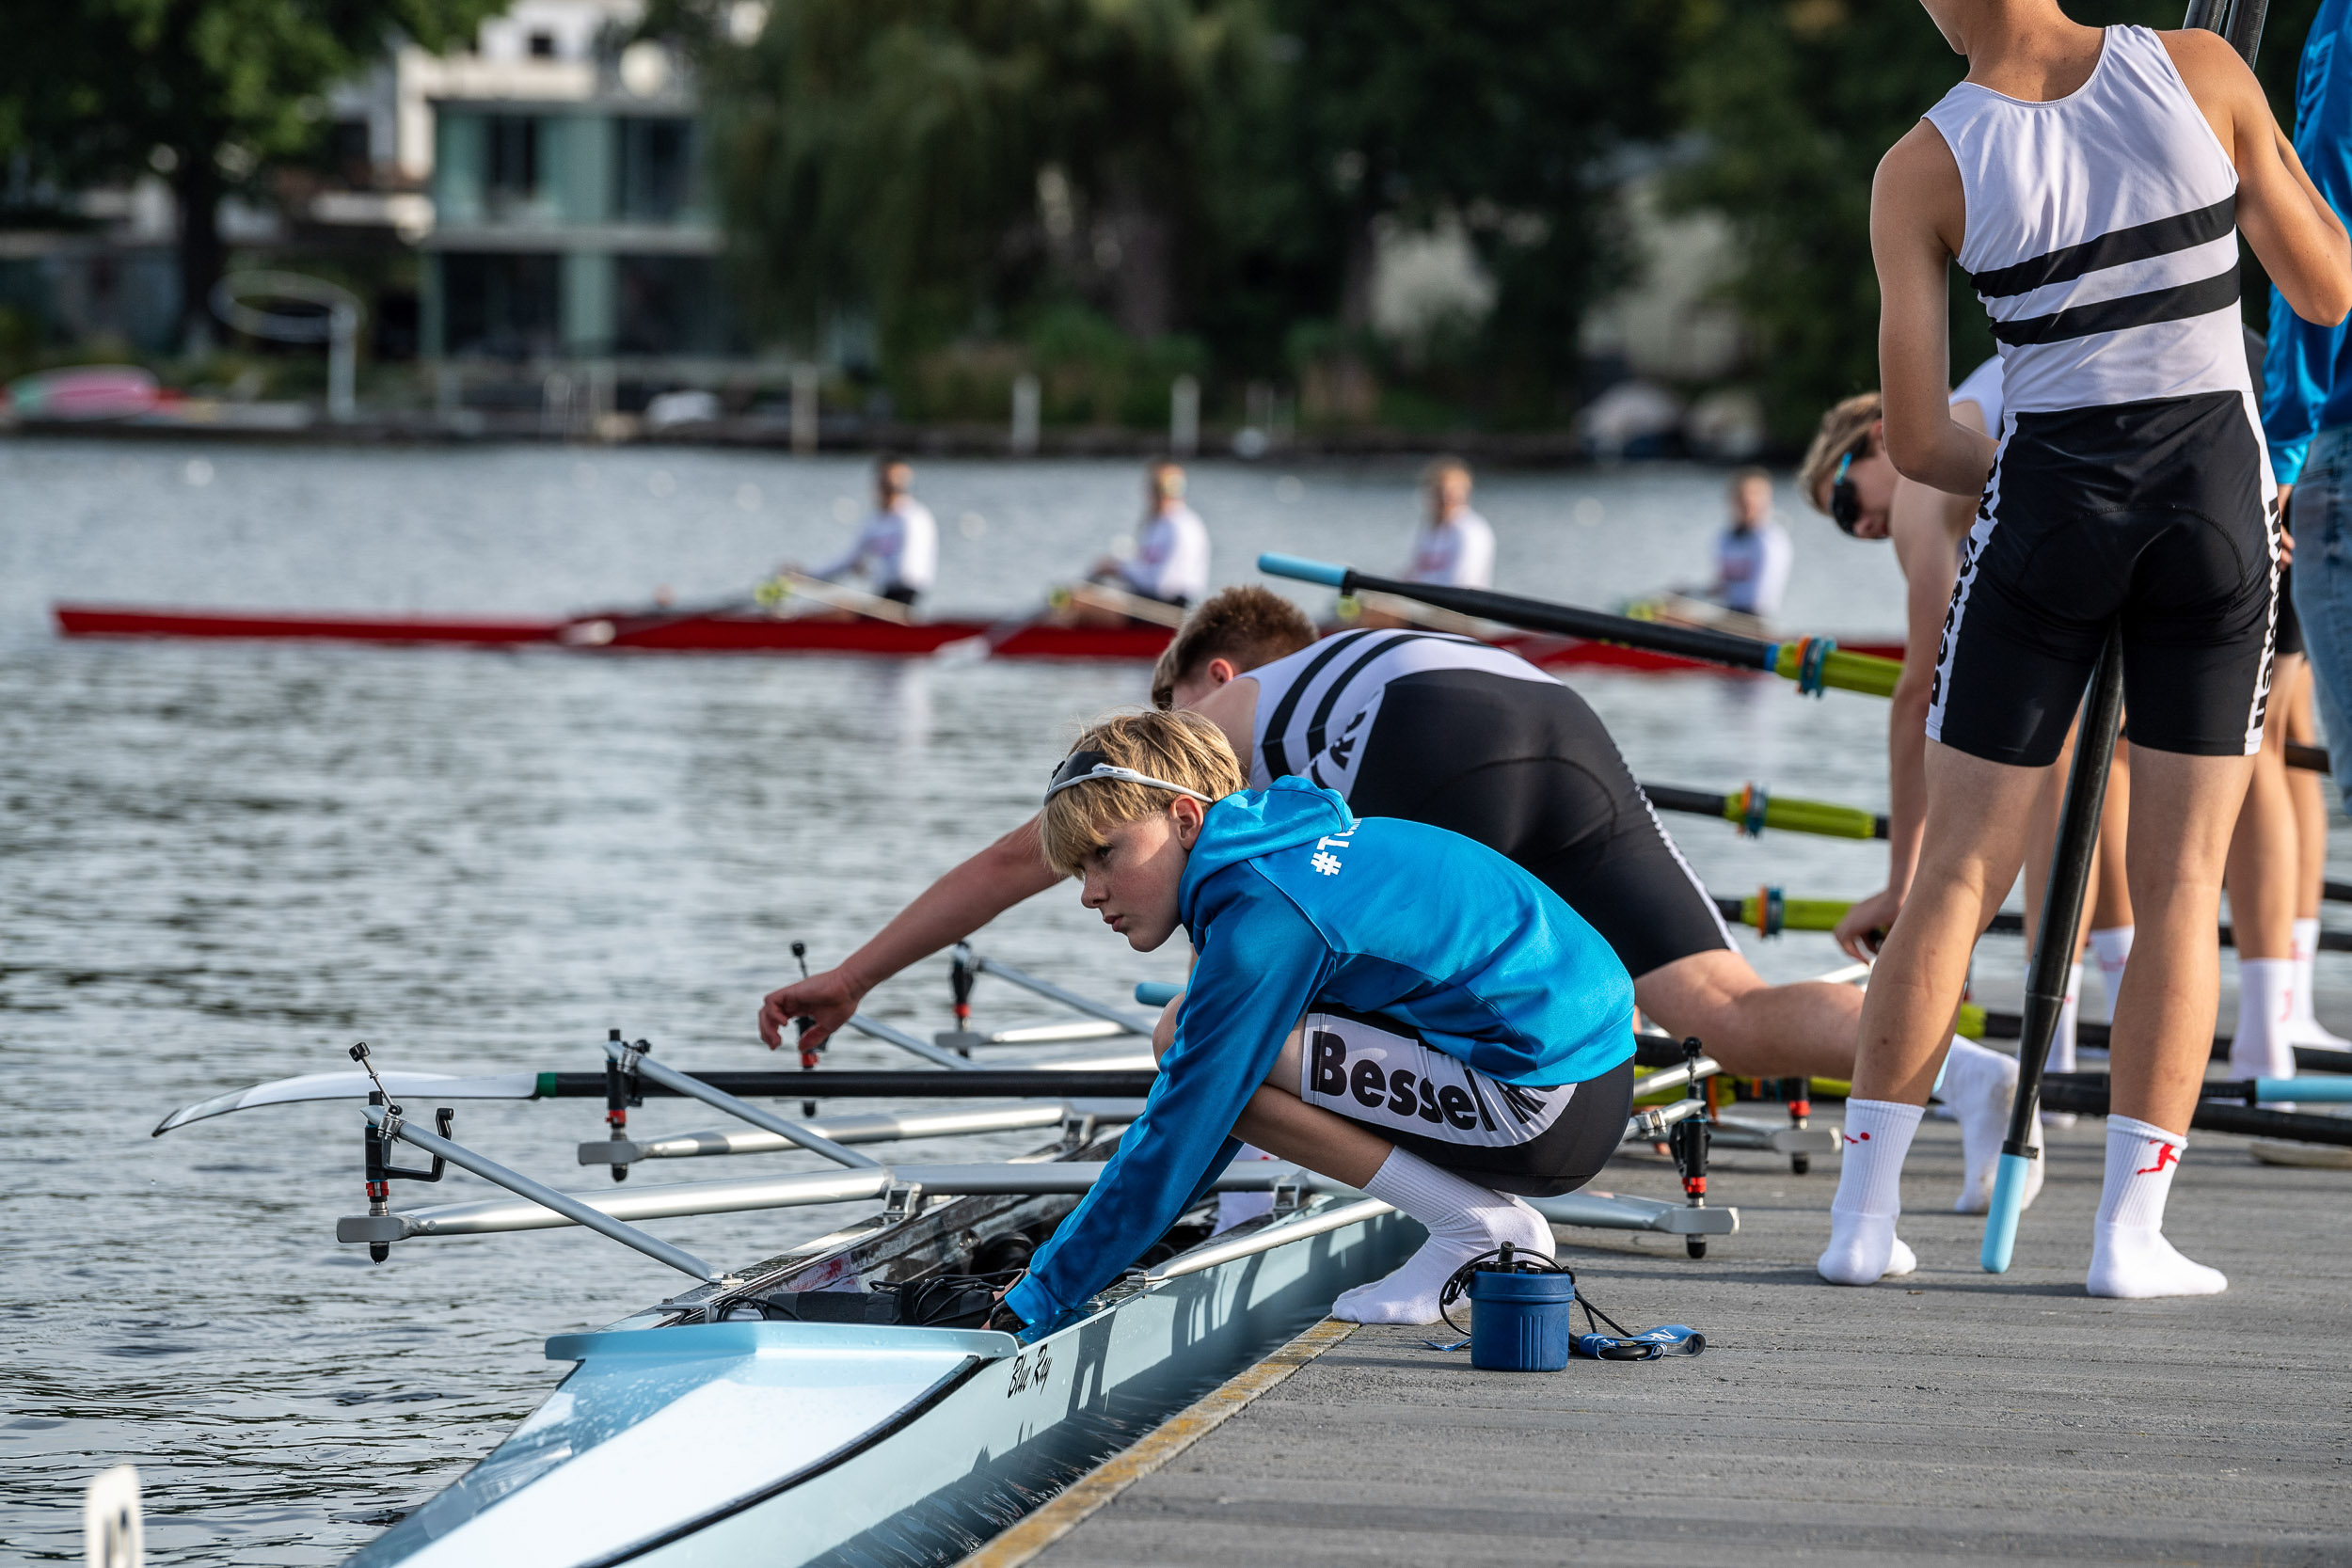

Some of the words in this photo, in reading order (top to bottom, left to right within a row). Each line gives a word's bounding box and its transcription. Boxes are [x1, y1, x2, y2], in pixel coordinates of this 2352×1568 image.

[1310, 1030, 1498, 1132] Bessel
[1008, 1354, 1032, 1399] Blue
[1030, 1342, 1054, 1396] Ray
